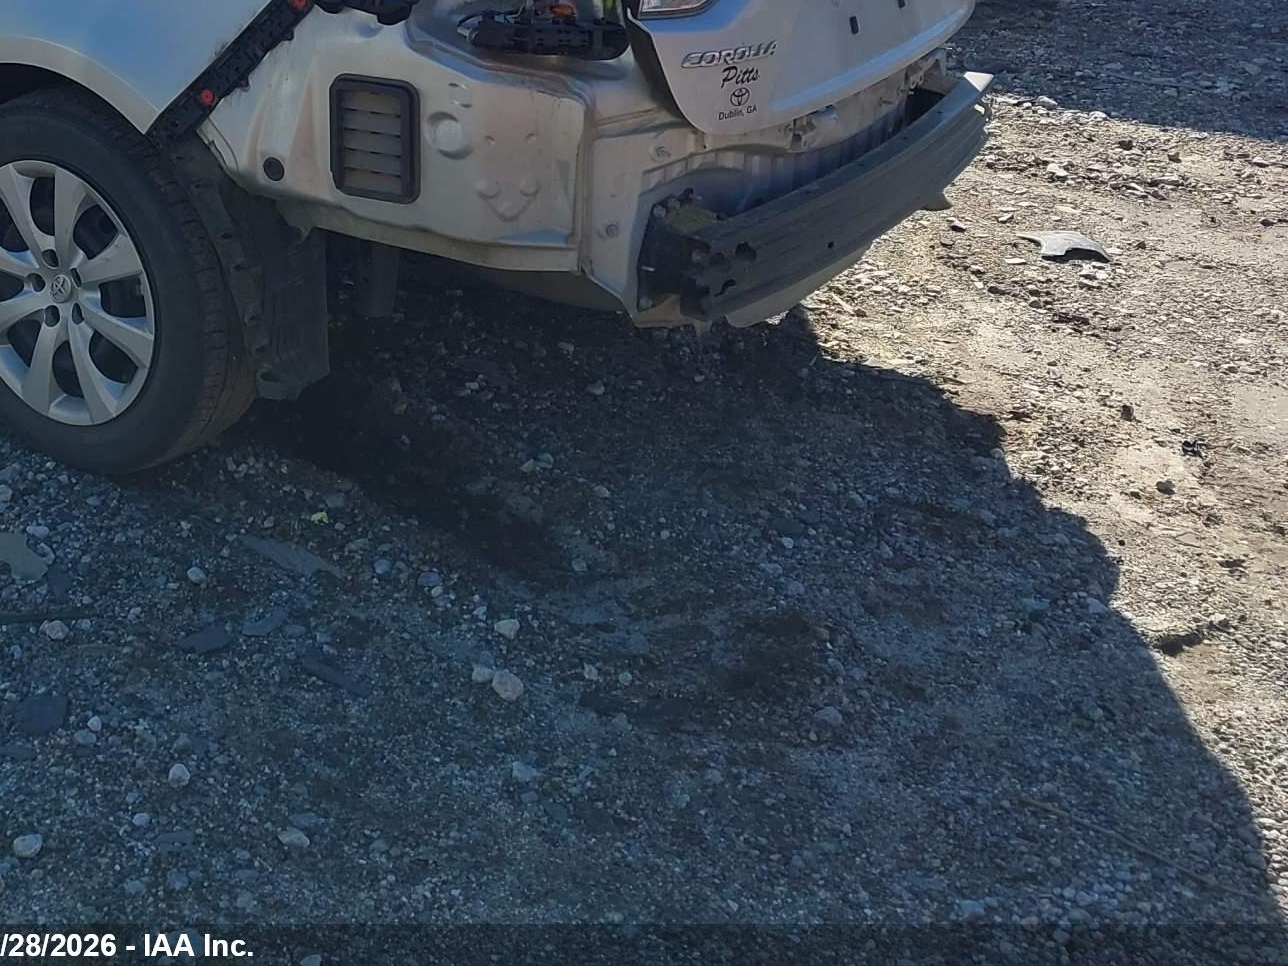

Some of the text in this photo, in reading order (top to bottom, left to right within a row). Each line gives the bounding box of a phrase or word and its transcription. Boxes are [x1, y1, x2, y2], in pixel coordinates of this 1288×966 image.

[681, 40, 777, 68] COROLLA
[721, 66, 760, 89] Pitts
[718, 105, 757, 121] Dublin, GA
